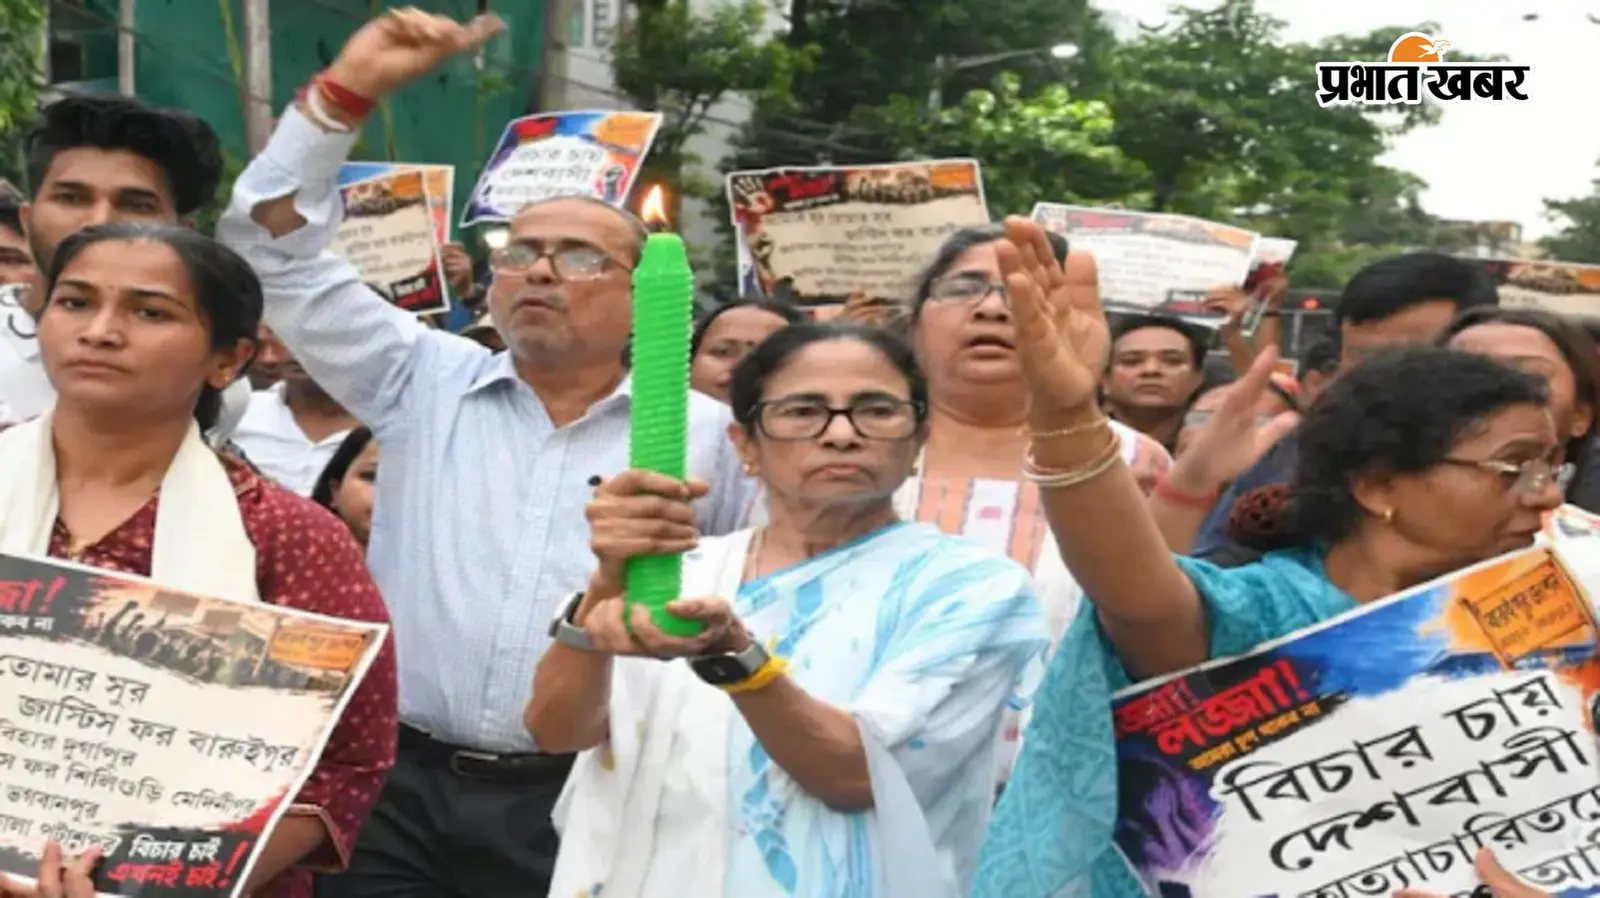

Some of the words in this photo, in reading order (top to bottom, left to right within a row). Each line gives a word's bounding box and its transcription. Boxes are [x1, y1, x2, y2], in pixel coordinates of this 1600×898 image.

[105, 674, 152, 709] সুর
[18, 694, 120, 736] জাস্টিস
[128, 717, 177, 747] ফর
[188, 729, 299, 773] বারুইপুর
[1222, 725, 1433, 822] বিচার
[1441, 676, 1563, 741] চায়
[23, 757, 60, 779] ফর
[1269, 726, 1590, 871] দেশবাসী
[129, 833, 187, 860] বিচার
[187, 835, 222, 862] চাই
